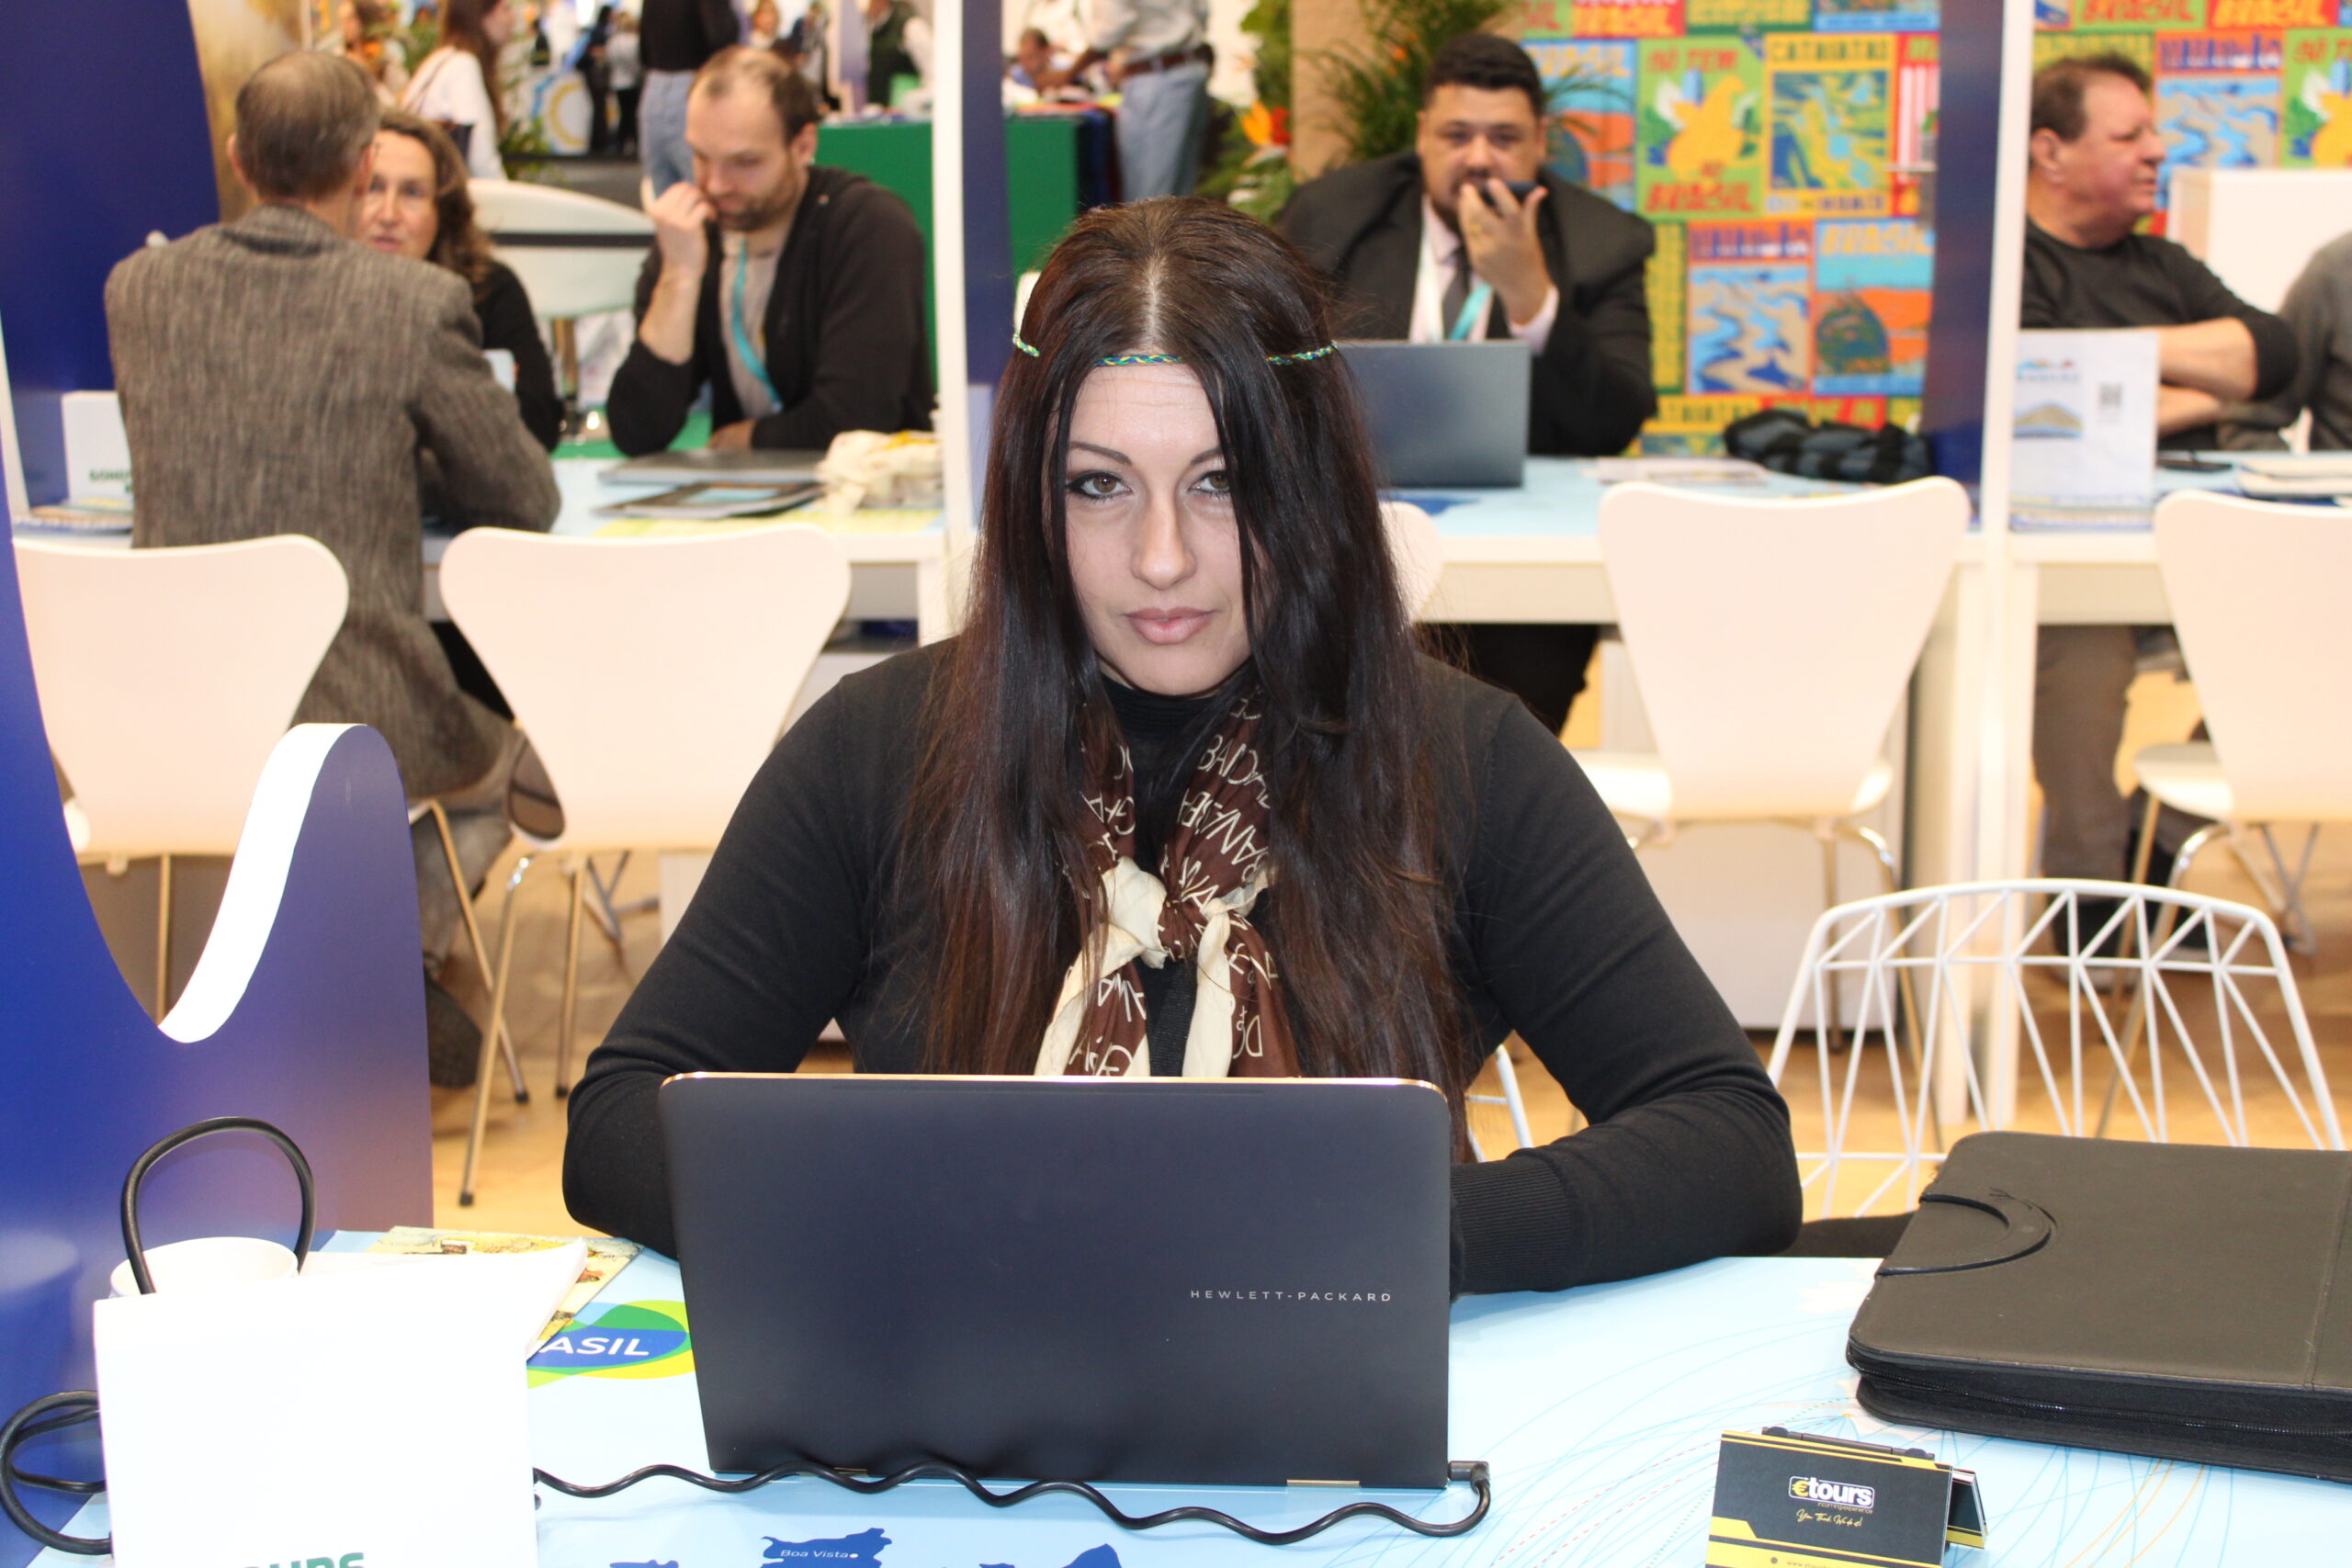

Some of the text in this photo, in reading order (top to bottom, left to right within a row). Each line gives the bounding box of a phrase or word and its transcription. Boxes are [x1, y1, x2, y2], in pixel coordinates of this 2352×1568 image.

[1190, 1290, 1392, 1303] HEWLETT-PACKARD
[539, 1337, 650, 1357] ASIL
[813, 1551, 849, 1559] Vista
